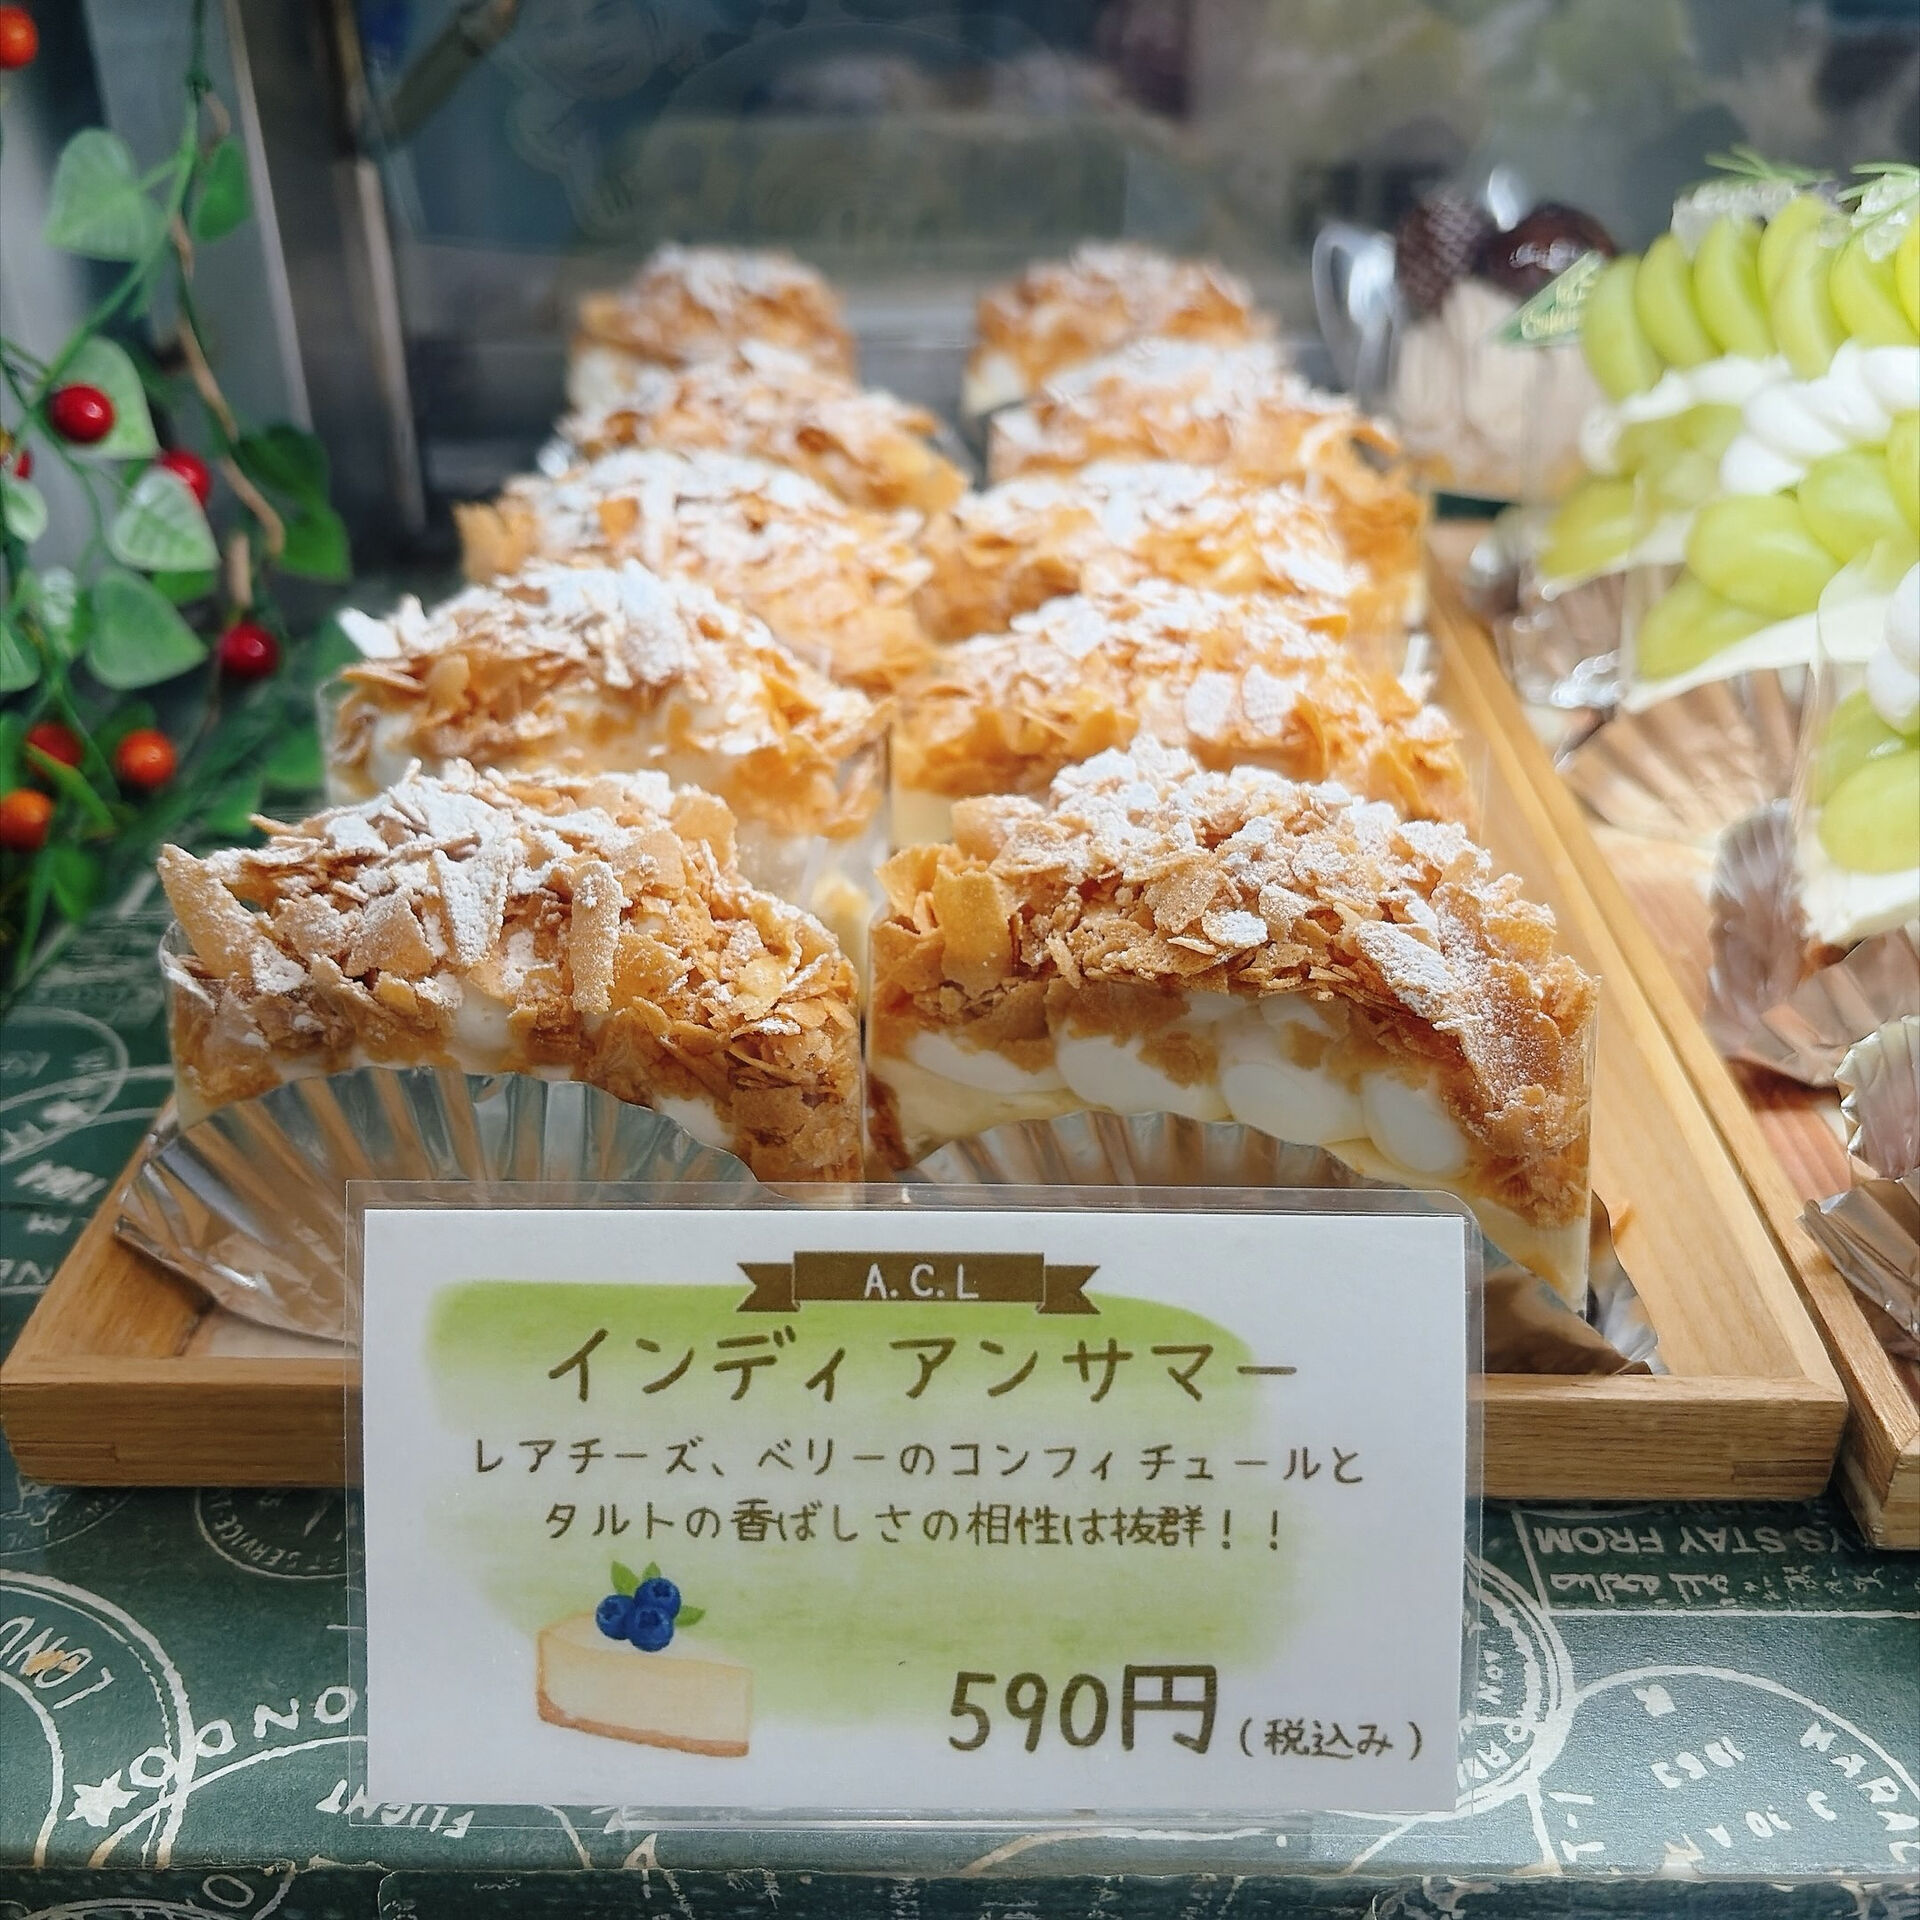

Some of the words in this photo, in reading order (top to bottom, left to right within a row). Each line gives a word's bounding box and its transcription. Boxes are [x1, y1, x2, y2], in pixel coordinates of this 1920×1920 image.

[864, 1263, 981, 1300] A.C.L
[547, 1325, 1298, 1404] インディアンサマー
[476, 1435, 1365, 1485] レアチーズ、ベリーのコンフィチュールと
[1536, 1527, 1663, 1554] FROM
[1680, 1527, 1786, 1554] STAY
[949, 1664, 1218, 1755] 590円
